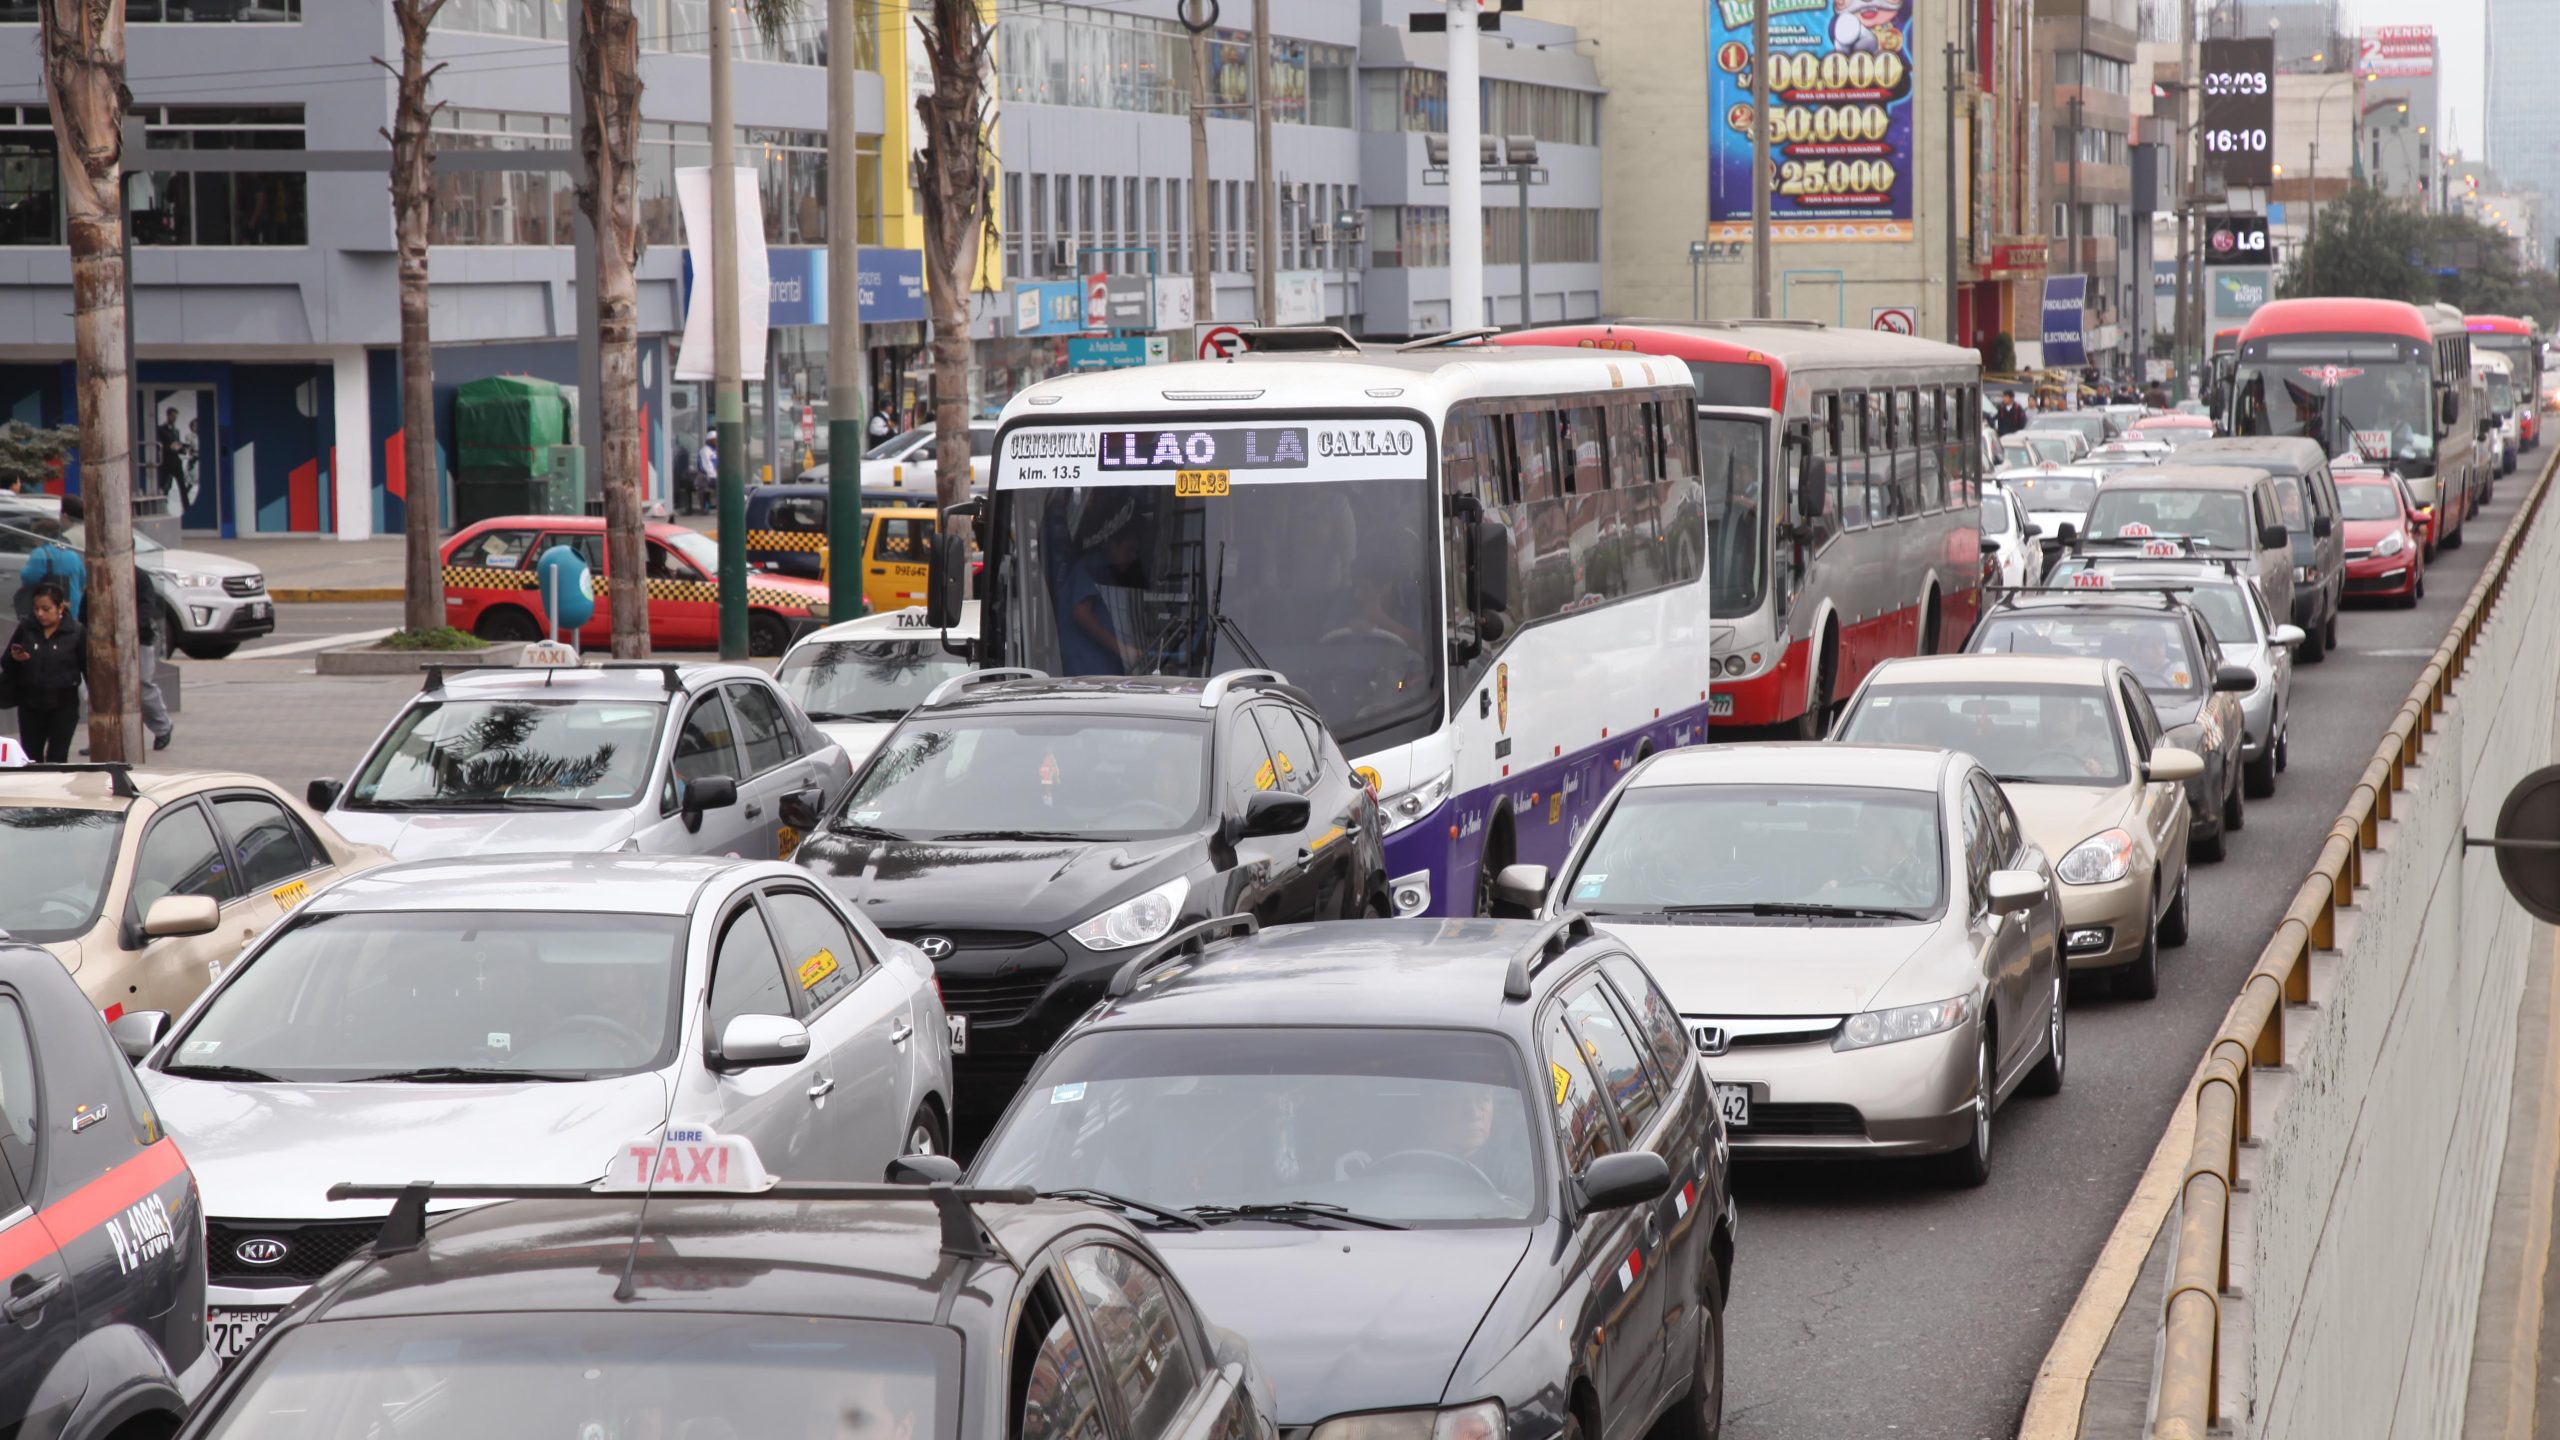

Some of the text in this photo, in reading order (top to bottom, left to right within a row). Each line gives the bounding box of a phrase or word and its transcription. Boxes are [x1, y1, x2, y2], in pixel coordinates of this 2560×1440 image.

[2205, 129, 2267, 151] 16:10
[2238, 231, 2265, 250] LG
[1010, 431, 1096, 459] CIENEGUILLA
[1246, 430, 1306, 463] LA
[1317, 430, 1413, 457] CALLAO
[1019, 466, 1080, 480] klm. 13.5
[2123, 527, 2148, 536] TAXI
[2146, 545, 2174, 555] TAXI
[2073, 576, 2104, 587] TAXI
[527, 650, 566, 664] TAXI
[1723, 1096, 1746, 1121] 42
[667, 1131, 702, 1142] LIBRE
[630, 1146, 729, 1185] TAXI
[244, 1244, 278, 1259] KIA
[230, 1312, 270, 1323] PERU
